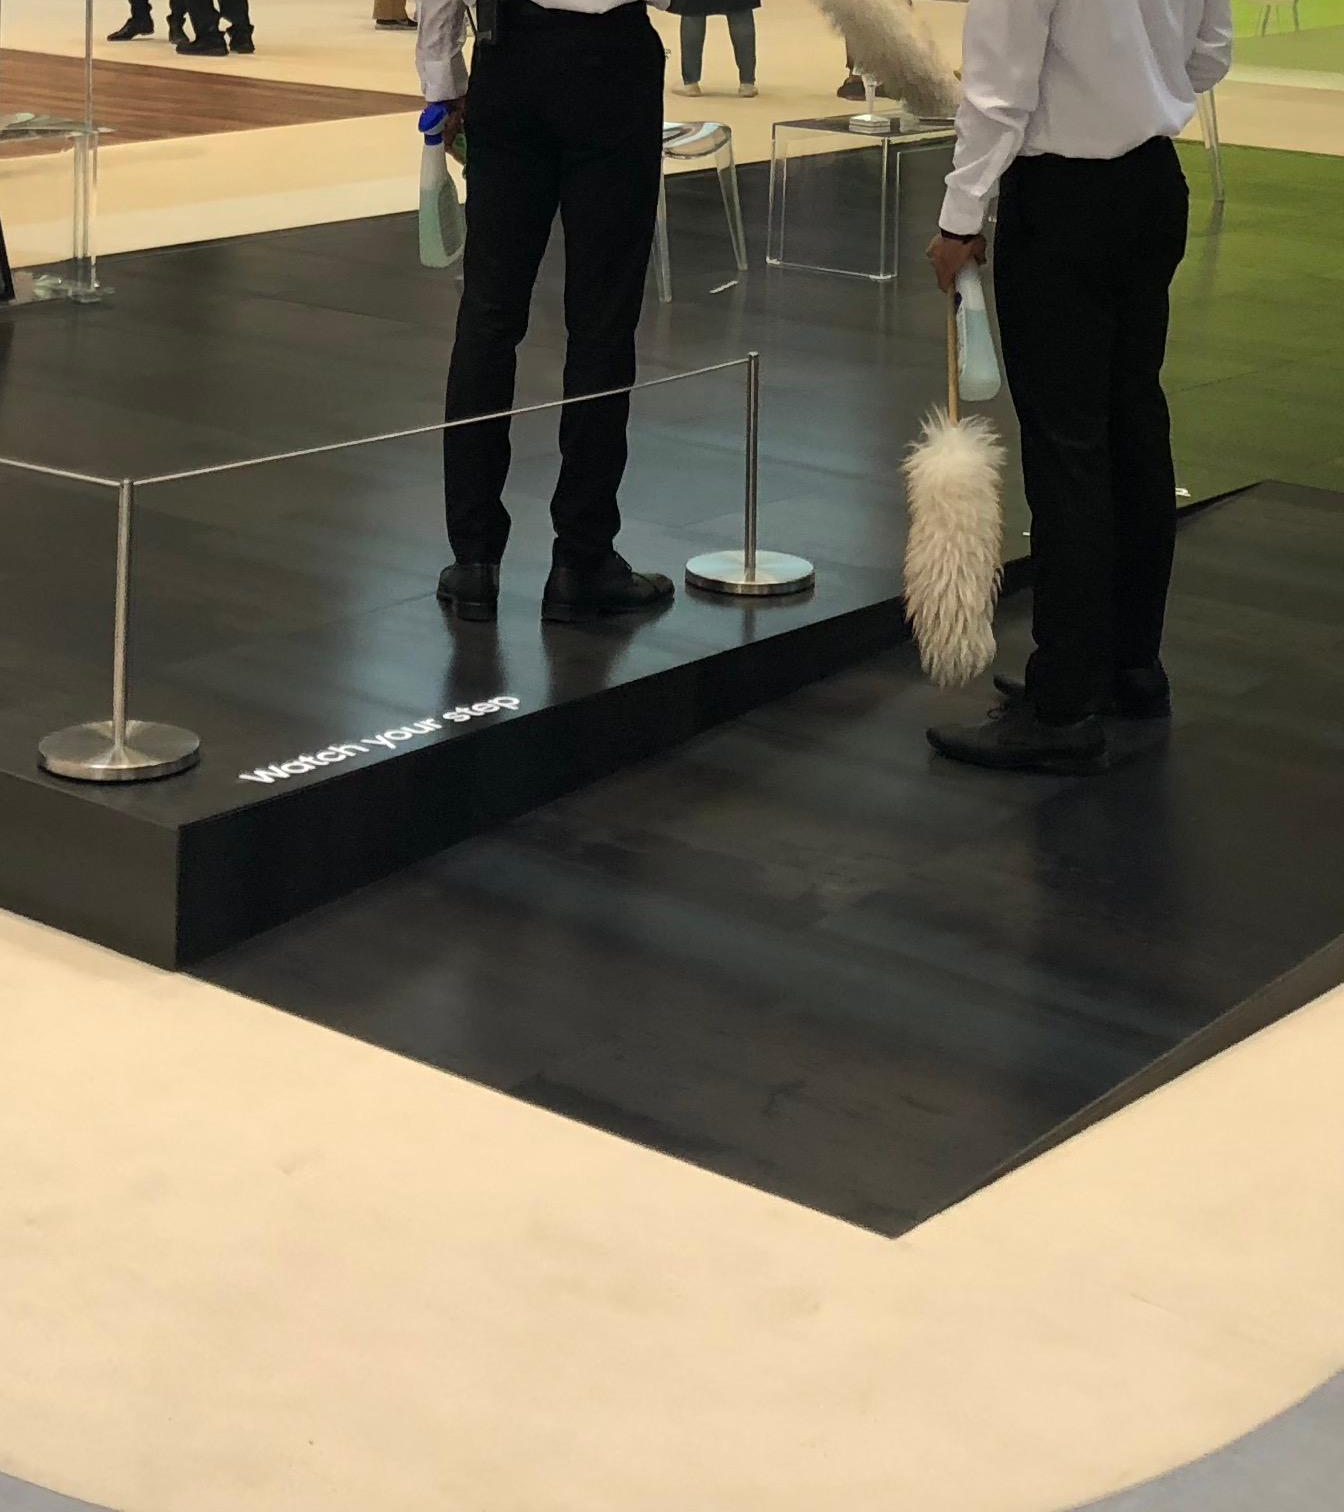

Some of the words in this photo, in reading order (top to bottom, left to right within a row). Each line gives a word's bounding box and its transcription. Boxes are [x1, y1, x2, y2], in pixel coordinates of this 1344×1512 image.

[238, 742, 370, 784] Watch
[361, 716, 443, 750] your
[443, 695, 521, 723] step
